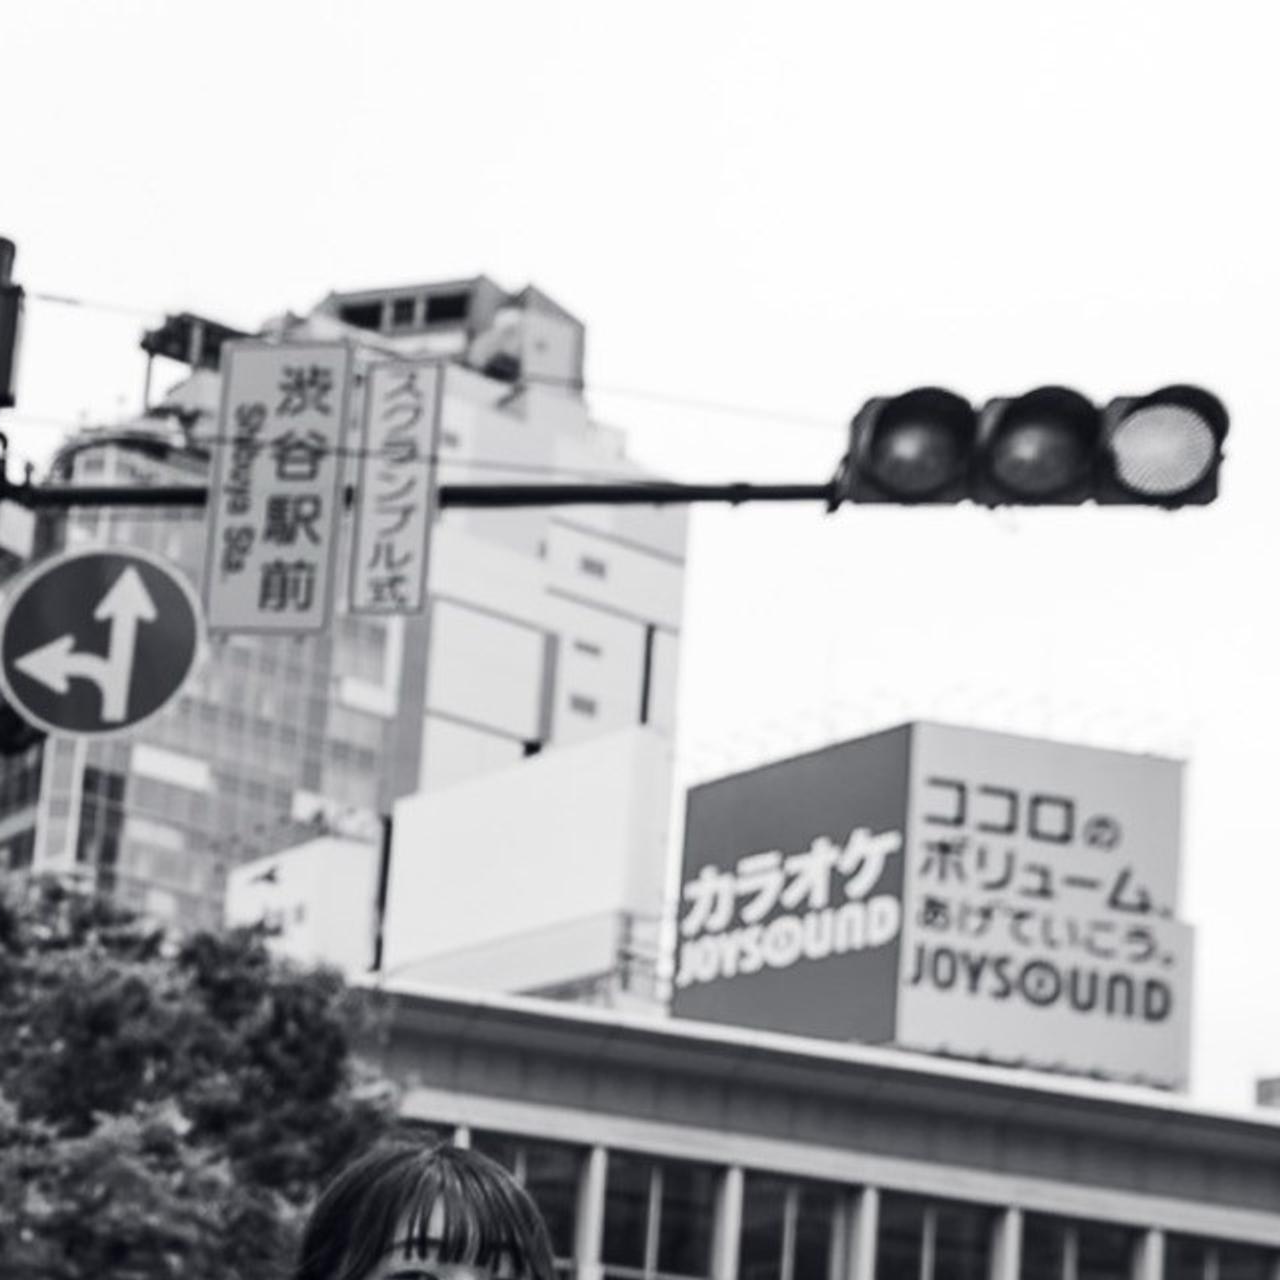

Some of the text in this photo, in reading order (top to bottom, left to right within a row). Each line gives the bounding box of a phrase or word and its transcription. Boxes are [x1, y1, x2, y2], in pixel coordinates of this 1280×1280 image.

[258, 364, 333, 613] 渋谷駅前
[925, 776, 1122, 853] ココロの
[680, 826, 903, 938] カラオケ
[675, 893, 902, 988] JOYSOUND
[911, 944, 1173, 1023] JOYSOUND
